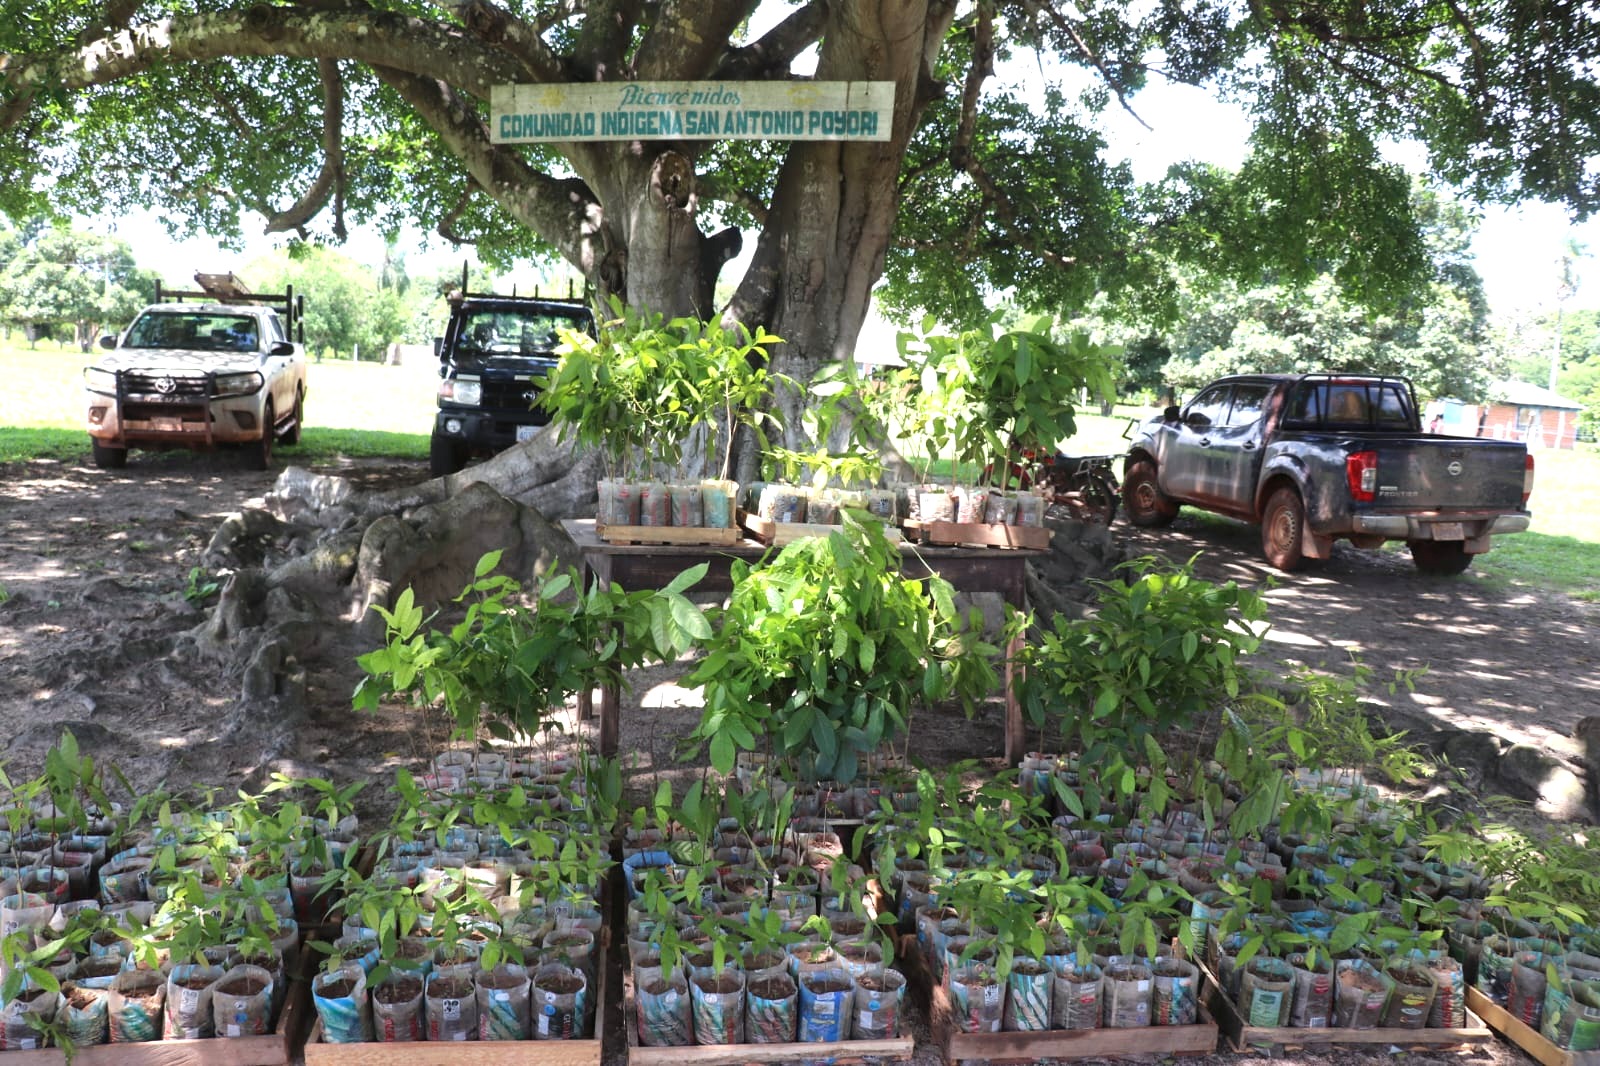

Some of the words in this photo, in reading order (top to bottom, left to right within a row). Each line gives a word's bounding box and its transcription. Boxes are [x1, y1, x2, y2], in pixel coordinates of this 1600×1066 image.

[619, 83, 741, 110] Bienvenidos
[500, 113, 595, 138] COMUNIDAD
[601, 110, 682, 136] INDIGENA
[685, 111, 720, 135] SAN
[724, 110, 804, 135] ANTONIO
[808, 110, 879, 135] POYORI
